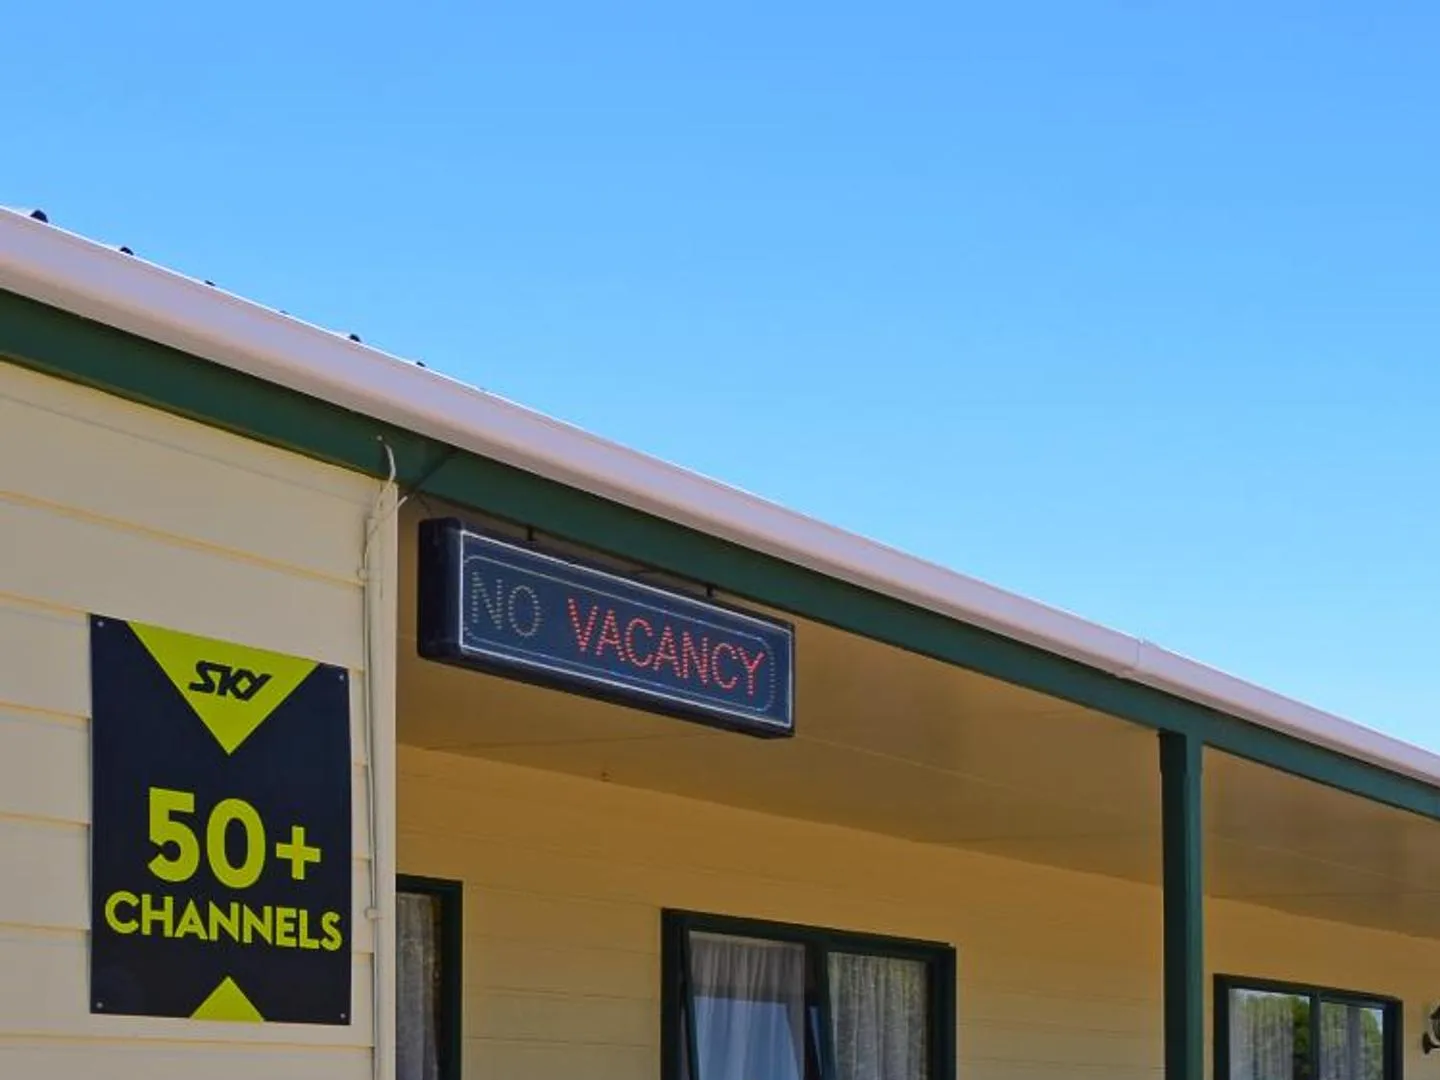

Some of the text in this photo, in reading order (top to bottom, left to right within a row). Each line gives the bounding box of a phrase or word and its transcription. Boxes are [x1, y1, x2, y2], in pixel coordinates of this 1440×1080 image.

[471, 571, 765, 696] NO VACANCY
[188, 660, 272, 702] SKY
[147, 786, 321, 889] 50+
[104, 890, 343, 951] CHANNELS
